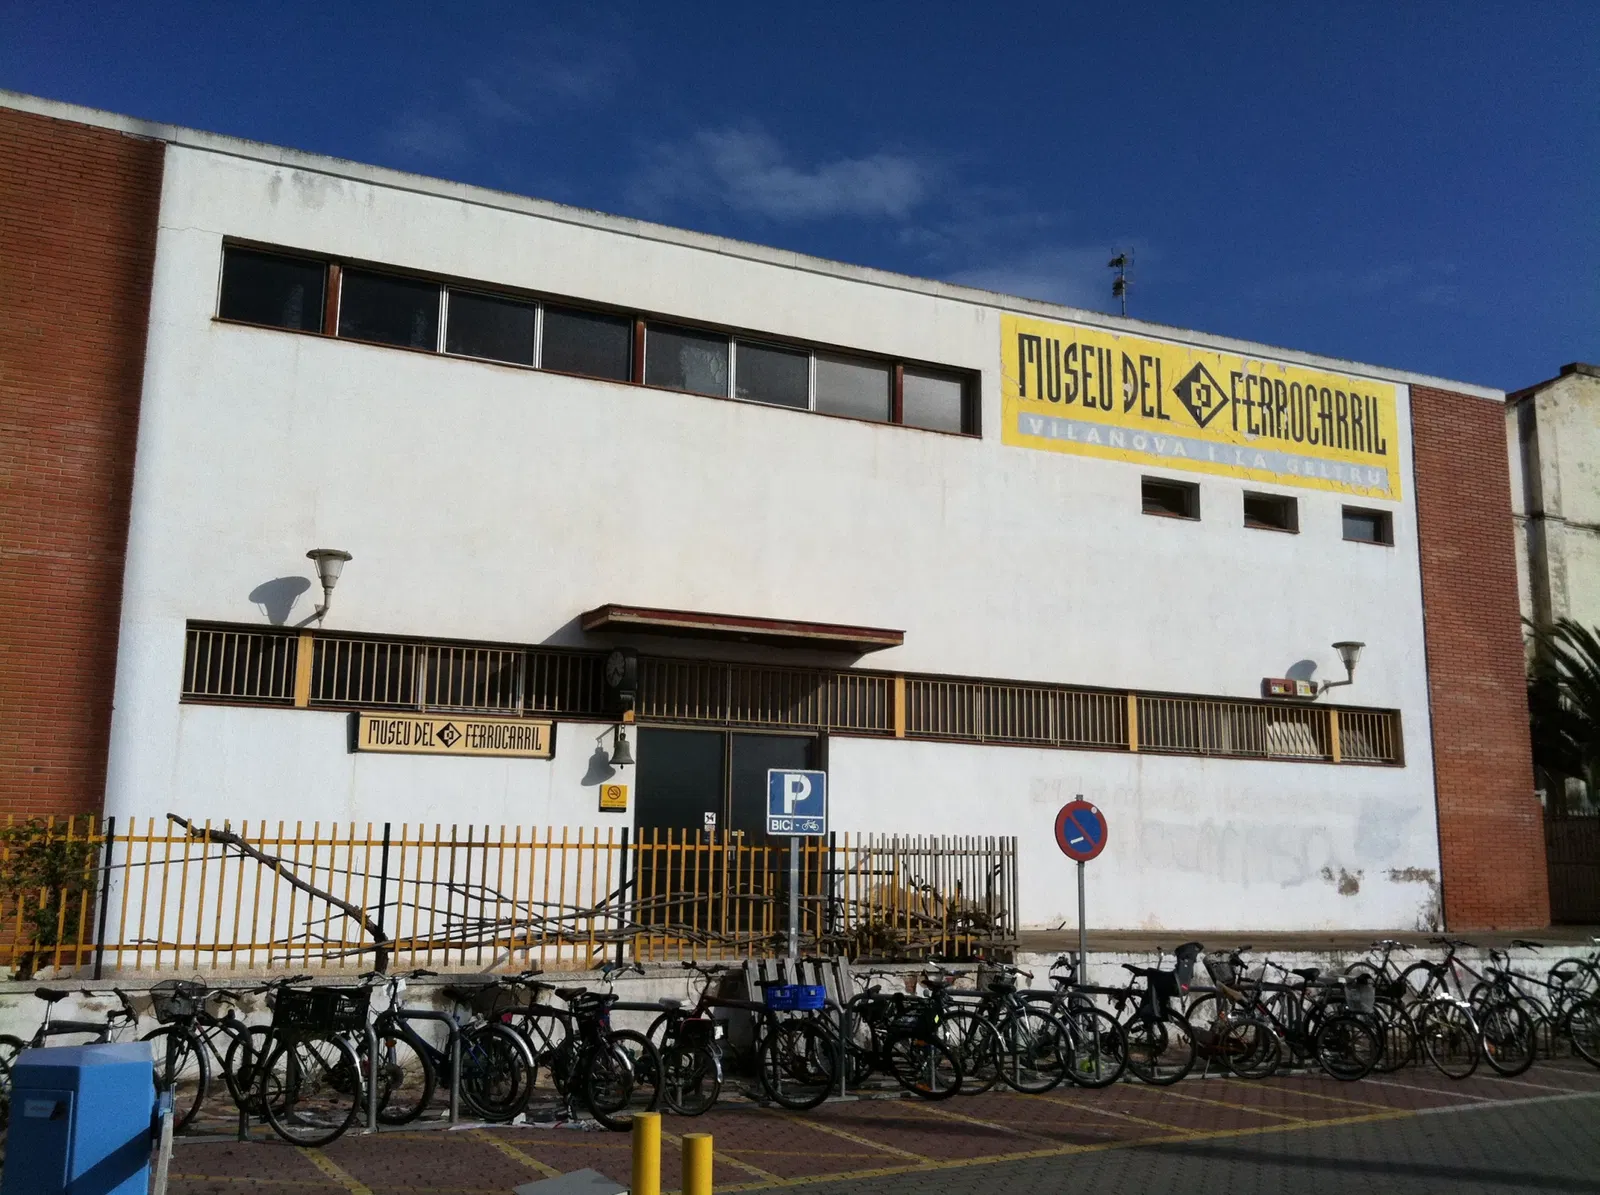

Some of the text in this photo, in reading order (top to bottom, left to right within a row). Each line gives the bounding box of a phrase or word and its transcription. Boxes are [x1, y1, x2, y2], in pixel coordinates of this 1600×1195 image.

[1018, 333, 1386, 455] MUSEU DEL FERROCARRIL
[1029, 418, 1187, 457] VILANOVA
[1235, 450, 1267, 469] LA
[368, 720, 542, 751] MUSEU DEL FERROCARRIL
[784, 774, 811, 813] P
[771, 819, 793, 831] BICI
